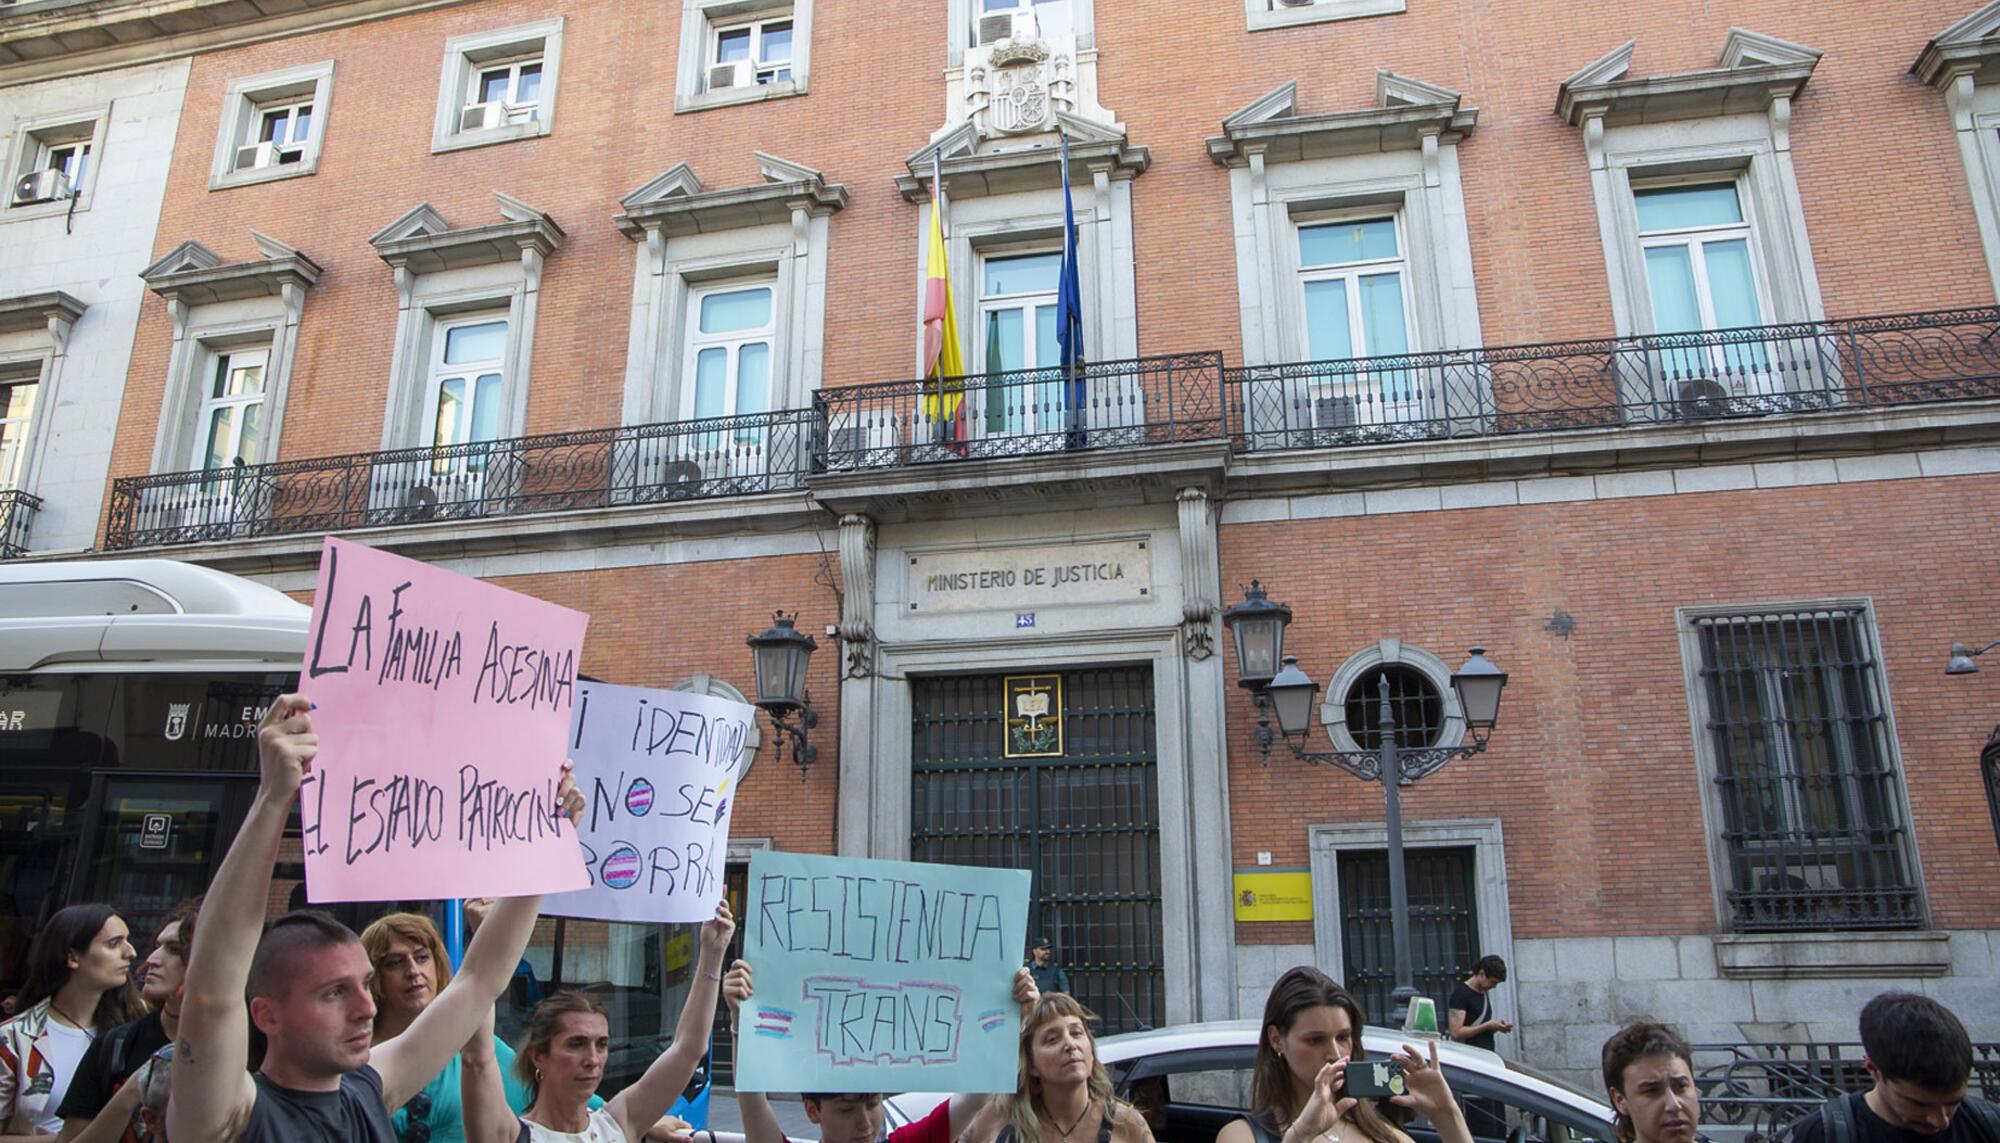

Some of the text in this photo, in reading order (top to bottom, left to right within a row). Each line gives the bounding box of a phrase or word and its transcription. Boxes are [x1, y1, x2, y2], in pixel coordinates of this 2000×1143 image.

[927, 563, 1125, 593] MINISTERIO DE JUSTICIA
[309, 546, 573, 712] LA FAMILIA ASESINA
[1017, 615, 1033, 626] 45
[203, 722, 258, 739] MADR
[242, 705, 269, 721] EM
[346, 774, 444, 866] ESTADO
[590, 770, 716, 833] NO SE
[759, 872, 1004, 964] RESISTENCIA
[813, 986, 955, 1056] TRANS
